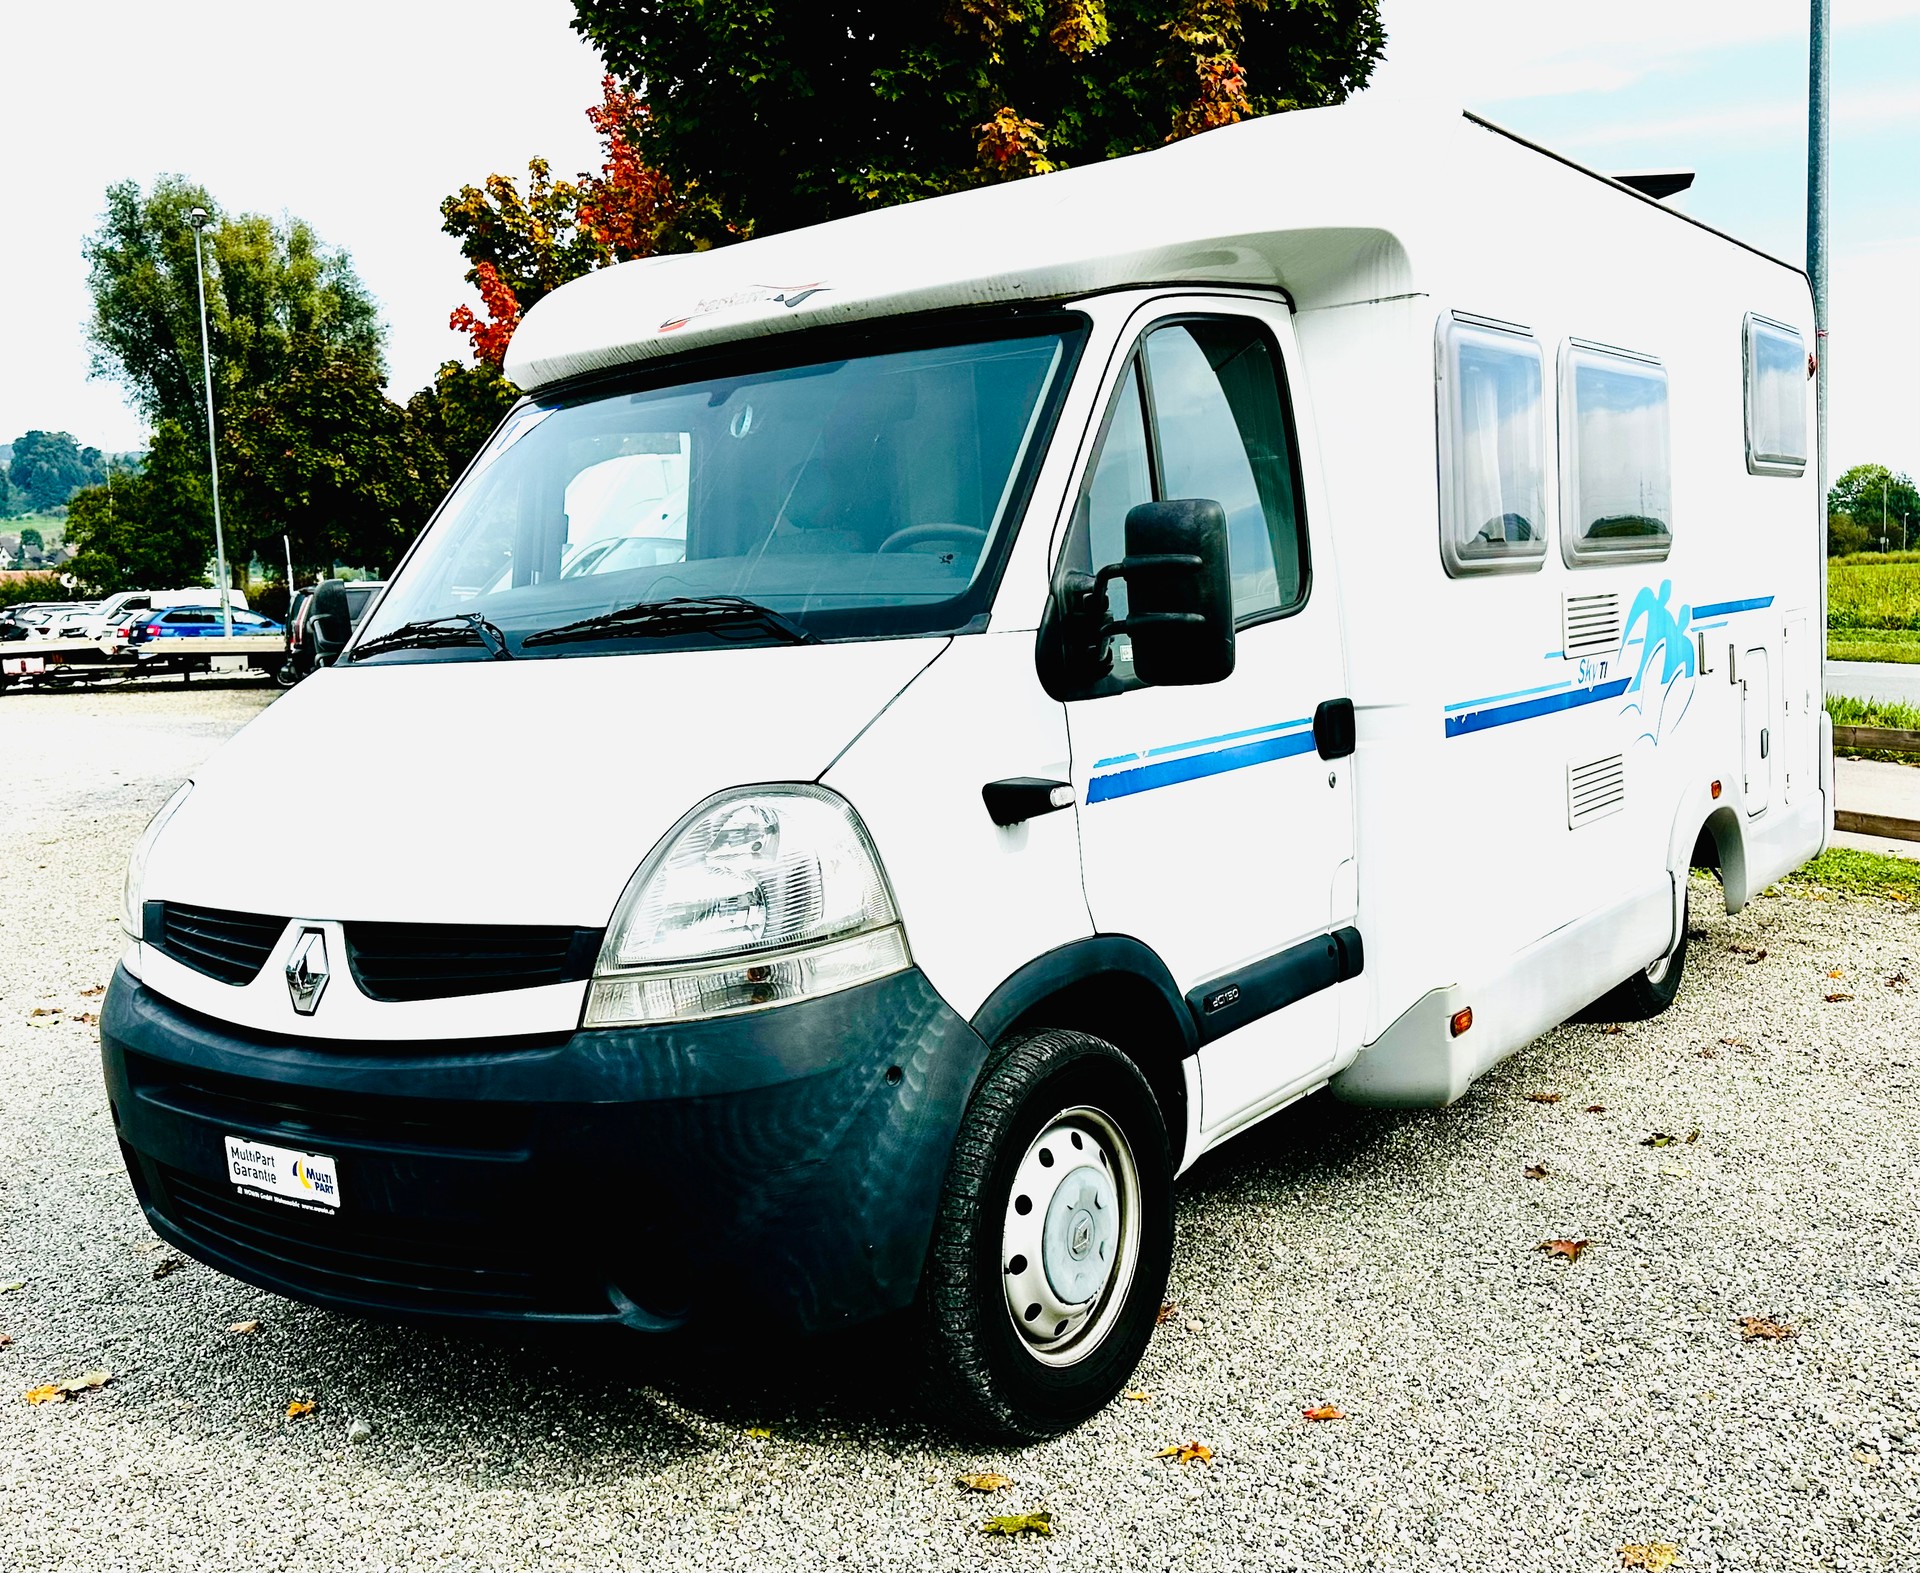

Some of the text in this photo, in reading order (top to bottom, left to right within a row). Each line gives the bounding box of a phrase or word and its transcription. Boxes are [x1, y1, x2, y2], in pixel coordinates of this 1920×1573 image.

[1578, 658, 1598, 692] Sky
[231, 1146, 275, 1167] MultiPart
[233, 1161, 277, 1184] Garantie
[306, 1167, 332, 1184] MULTI
[314, 1181, 334, 1195] PART
